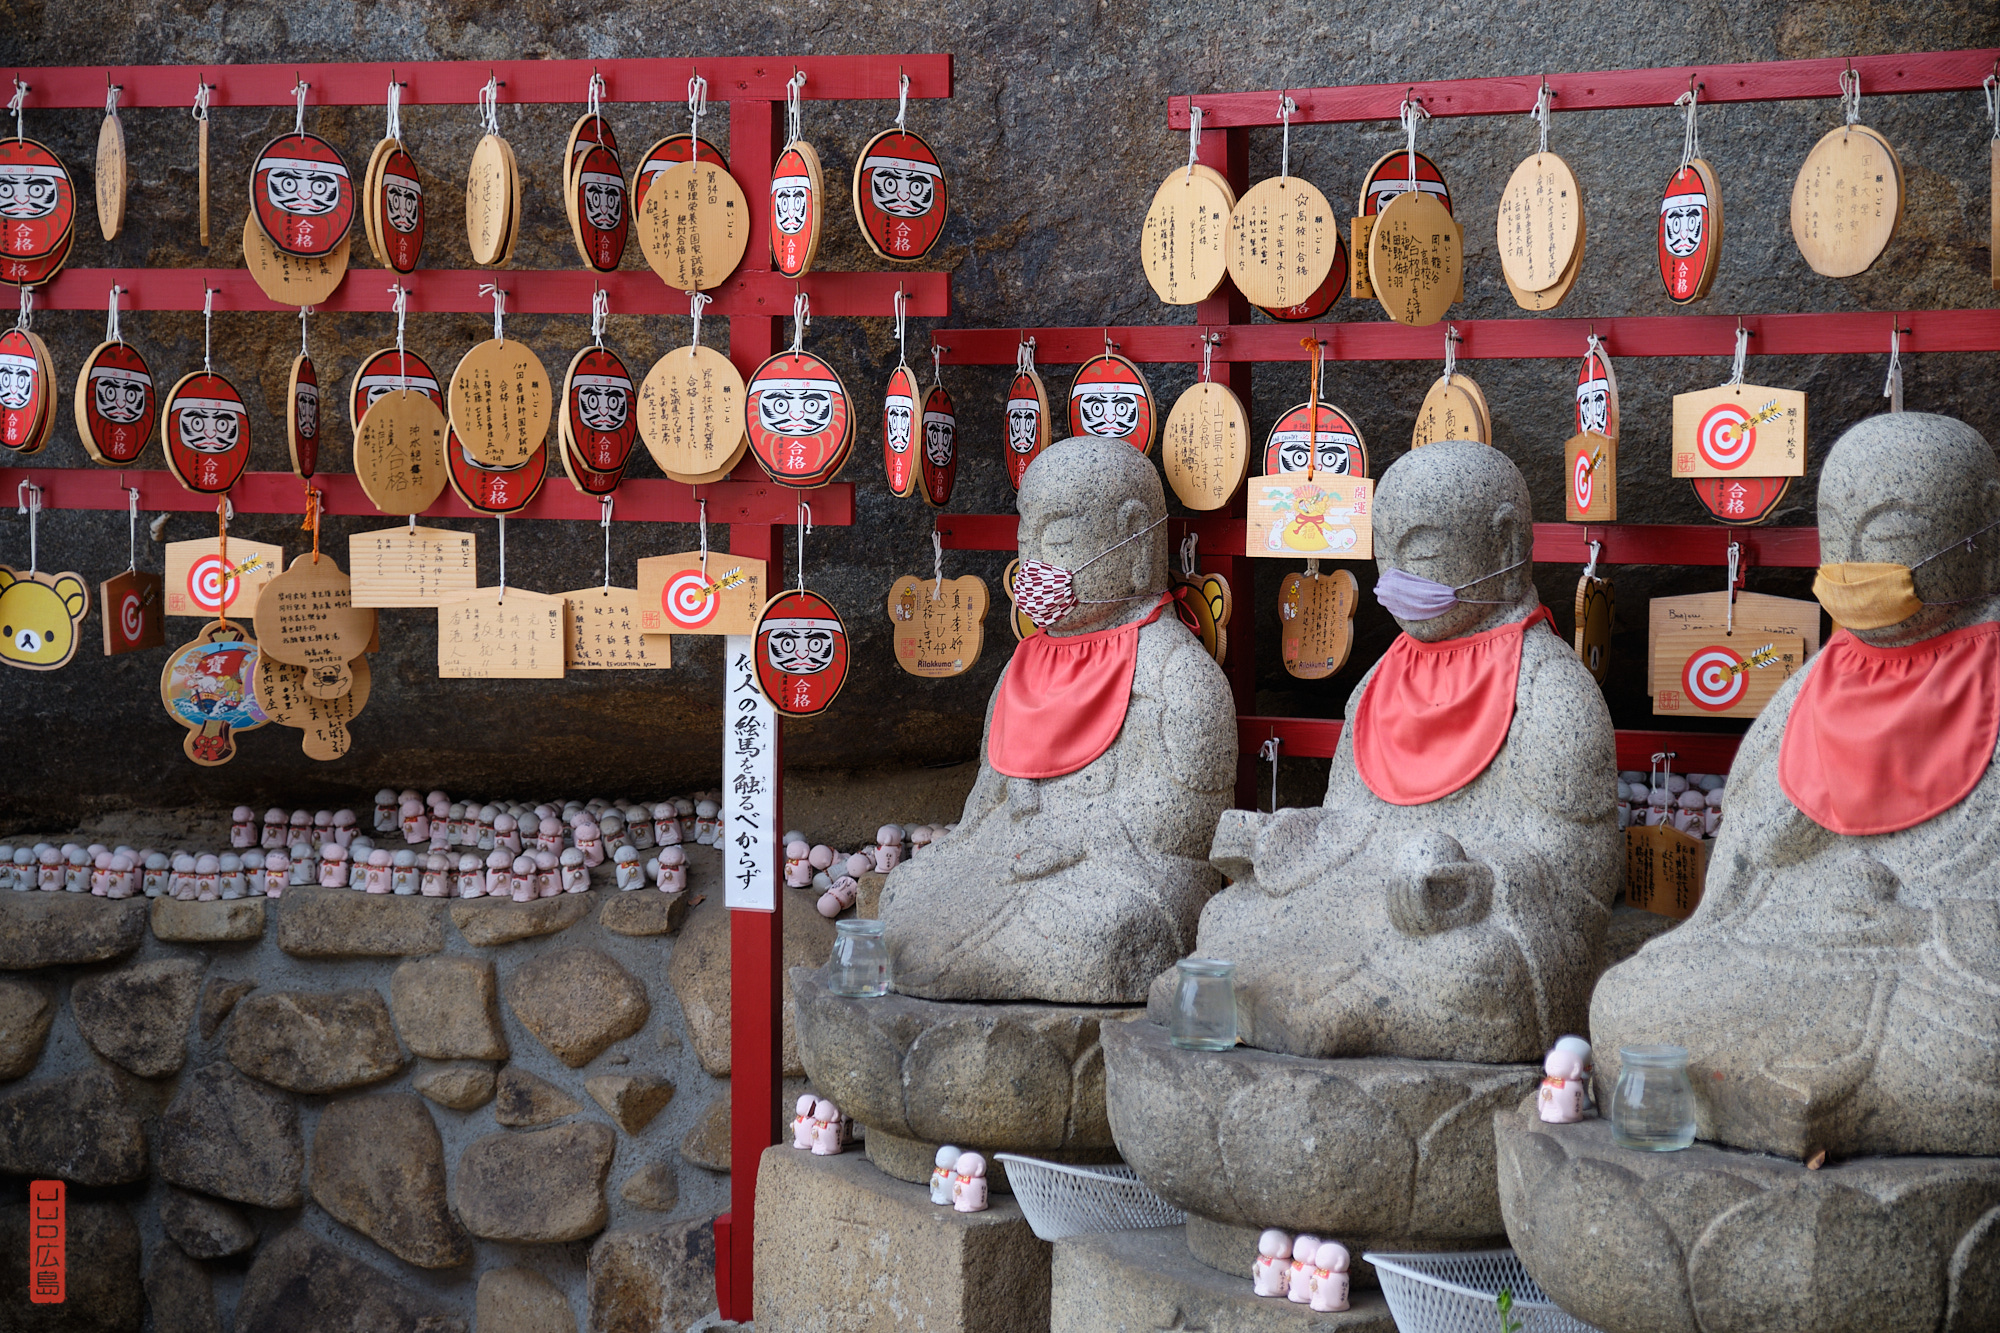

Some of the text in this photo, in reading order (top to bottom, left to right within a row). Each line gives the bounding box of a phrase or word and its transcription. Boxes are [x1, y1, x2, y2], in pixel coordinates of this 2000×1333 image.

[890, 160, 917, 169] 必勝
[706, 171, 718, 204] 第34回
[1875, 174, 1883, 218] 願いごと
[294, 219, 315, 248] 合格
[726, 200, 734, 238] 願いごと
[1212, 212, 1220, 251] 願いごと
[14, 223, 35, 251] 合格
[601, 235, 611, 264] 合格
[894, 222, 912, 251] 合格
[1295, 210, 1309, 276] 高校に合格
[1314, 215, 1323, 254] 願いごと
[398, 237, 408, 266] 合格
[786, 239, 796, 269] 合格
[9, 260, 29, 277] 格
[1677, 262, 1689, 293] 合格
[531, 381, 539, 418] 願いごと
[723, 386, 731, 423] 願いごと
[7, 413, 19, 441] 合格
[113, 428, 127, 455] 合格
[1786, 407, 1797, 460] 願かけ絵馬
[433, 429, 441, 466] 願いごと
[599, 436, 611, 464] 合格
[787, 440, 807, 470] 合格
[1213, 401, 1224, 500] 山口県立大学
[202, 457, 219, 486] 合格
[385, 444, 409, 492] 合格
[895, 457, 902, 487] 合格
[489, 476, 509, 505] 合格
[1353, 486, 1367, 515] 開運
[1726, 482, 1748, 514] 合格
[1302, 525, 1316, 540] 福
[461, 539, 469, 568] 願いごと
[748, 575, 758, 622] 願かけ絵馬
[548, 609, 557, 639] 願いごと
[788, 619, 816, 627] 必勝
[917, 660, 952, 668] Rilakkuma
[261, 662, 278, 711] 家内安全
[793, 678, 811, 708] 合格
[733, 653, 761, 890] 他人の絵馬を触るべからず
